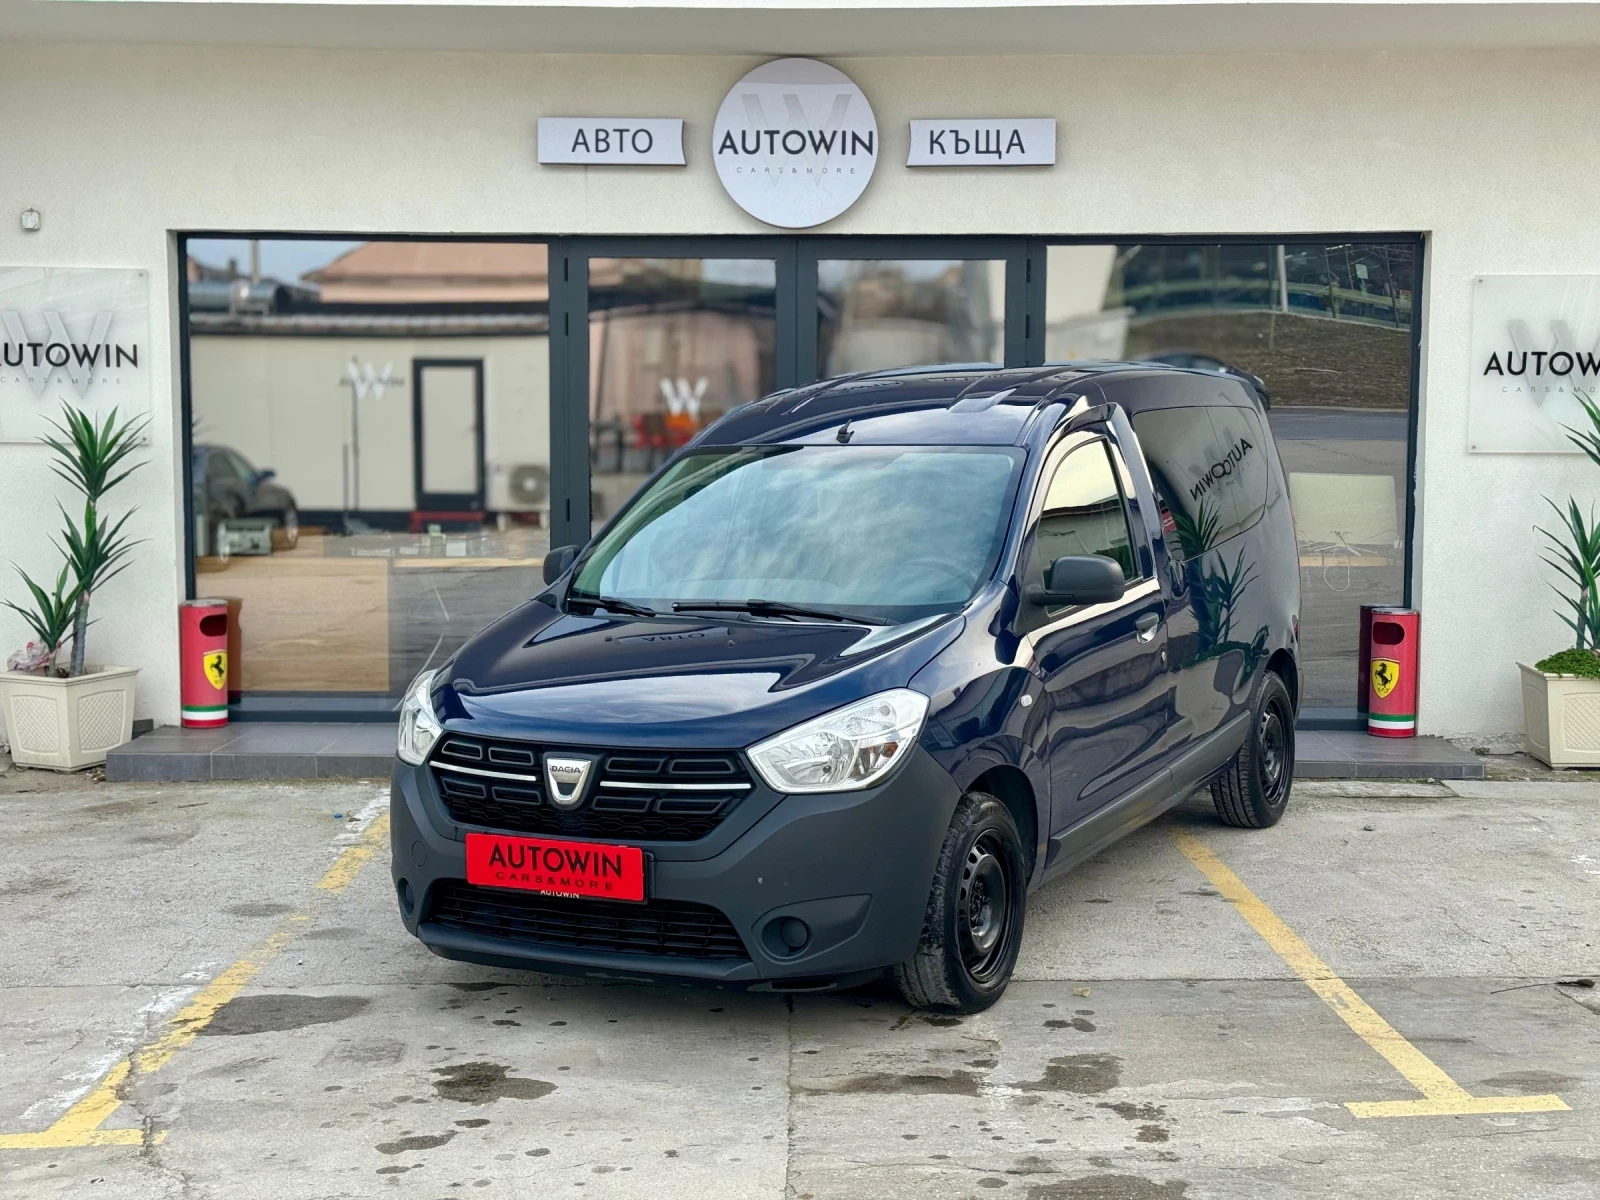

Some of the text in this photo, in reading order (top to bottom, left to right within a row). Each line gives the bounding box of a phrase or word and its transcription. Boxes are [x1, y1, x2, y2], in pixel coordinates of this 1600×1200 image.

[571, 128, 653, 154] АВТО
[717, 129, 874, 156] AUTOWIN
[929, 129, 1026, 160] КЪЩА
[736, 166, 856, 175] CARS&MORE
[0, 342, 138, 369] UTOWIN
[551, 765, 581, 774] DACIA
[488, 843, 622, 879] AUTOWIN
[495, 871, 613, 891] CARS&MORE
